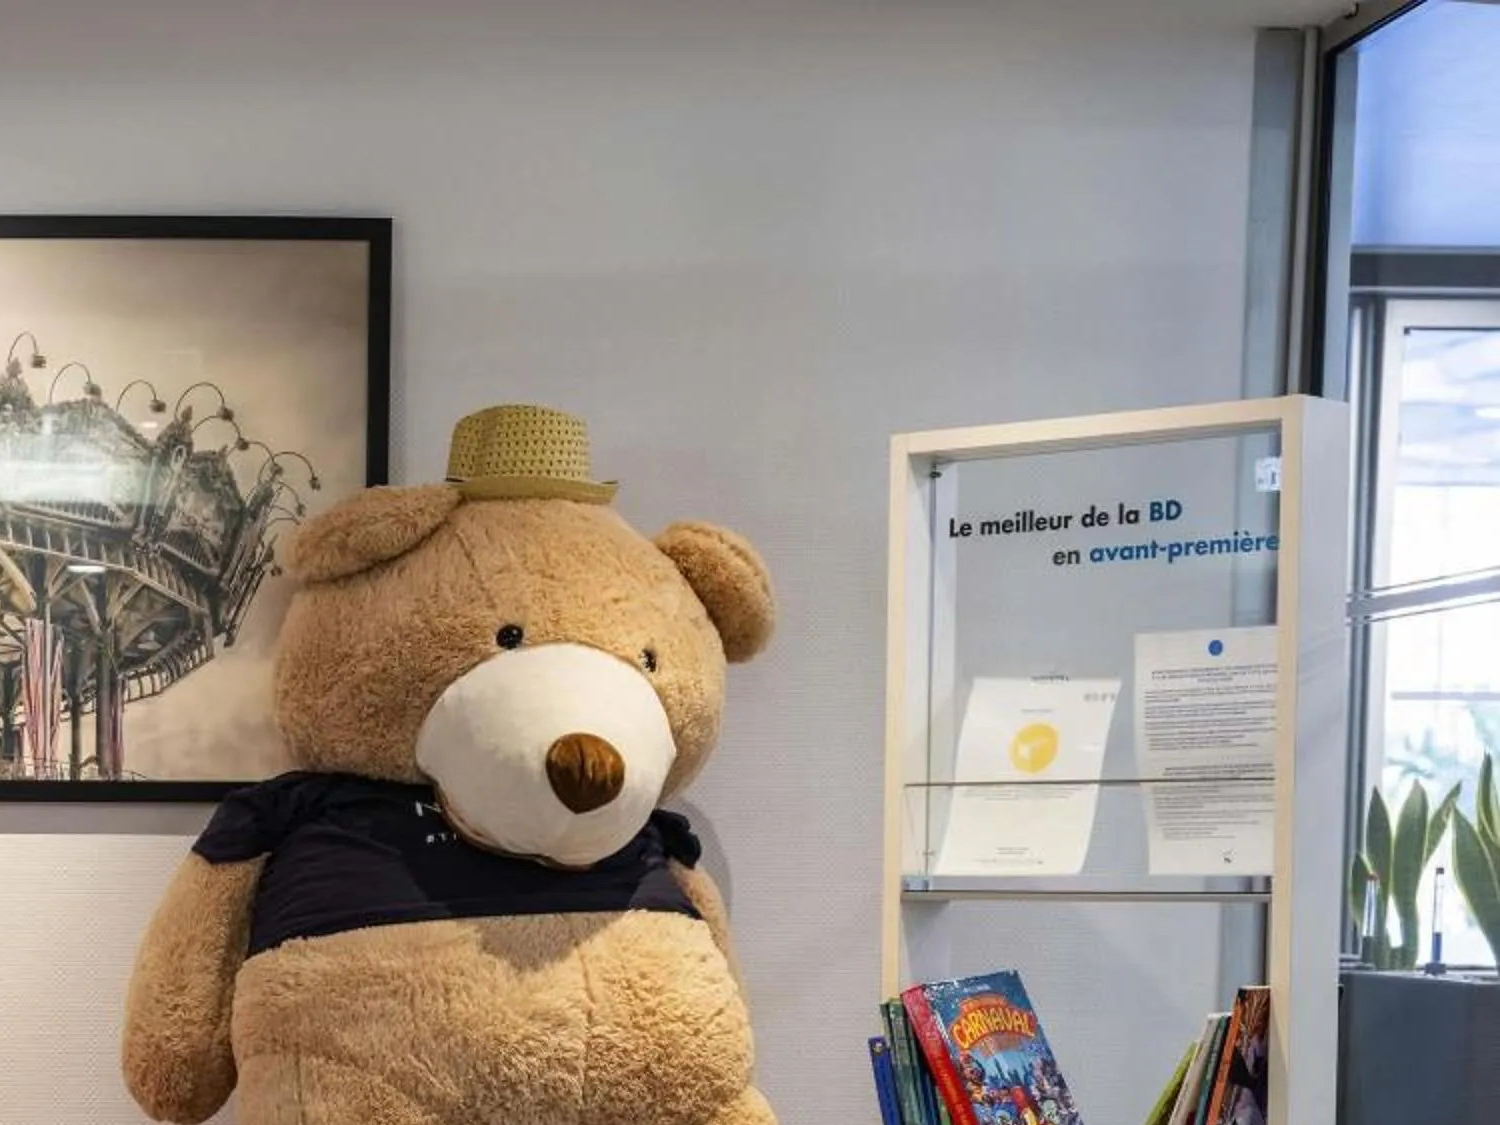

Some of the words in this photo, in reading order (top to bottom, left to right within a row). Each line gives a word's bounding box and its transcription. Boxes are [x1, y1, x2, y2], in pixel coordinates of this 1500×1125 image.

[949, 518, 973, 538] Le
[980, 509, 1073, 537] meilleur
[1081, 505, 1109, 529] de
[1118, 502, 1141, 525] la
[1149, 499, 1183, 522] BD
[1052, 548, 1081, 566] en
[1089, 531, 1280, 564] avant-première
